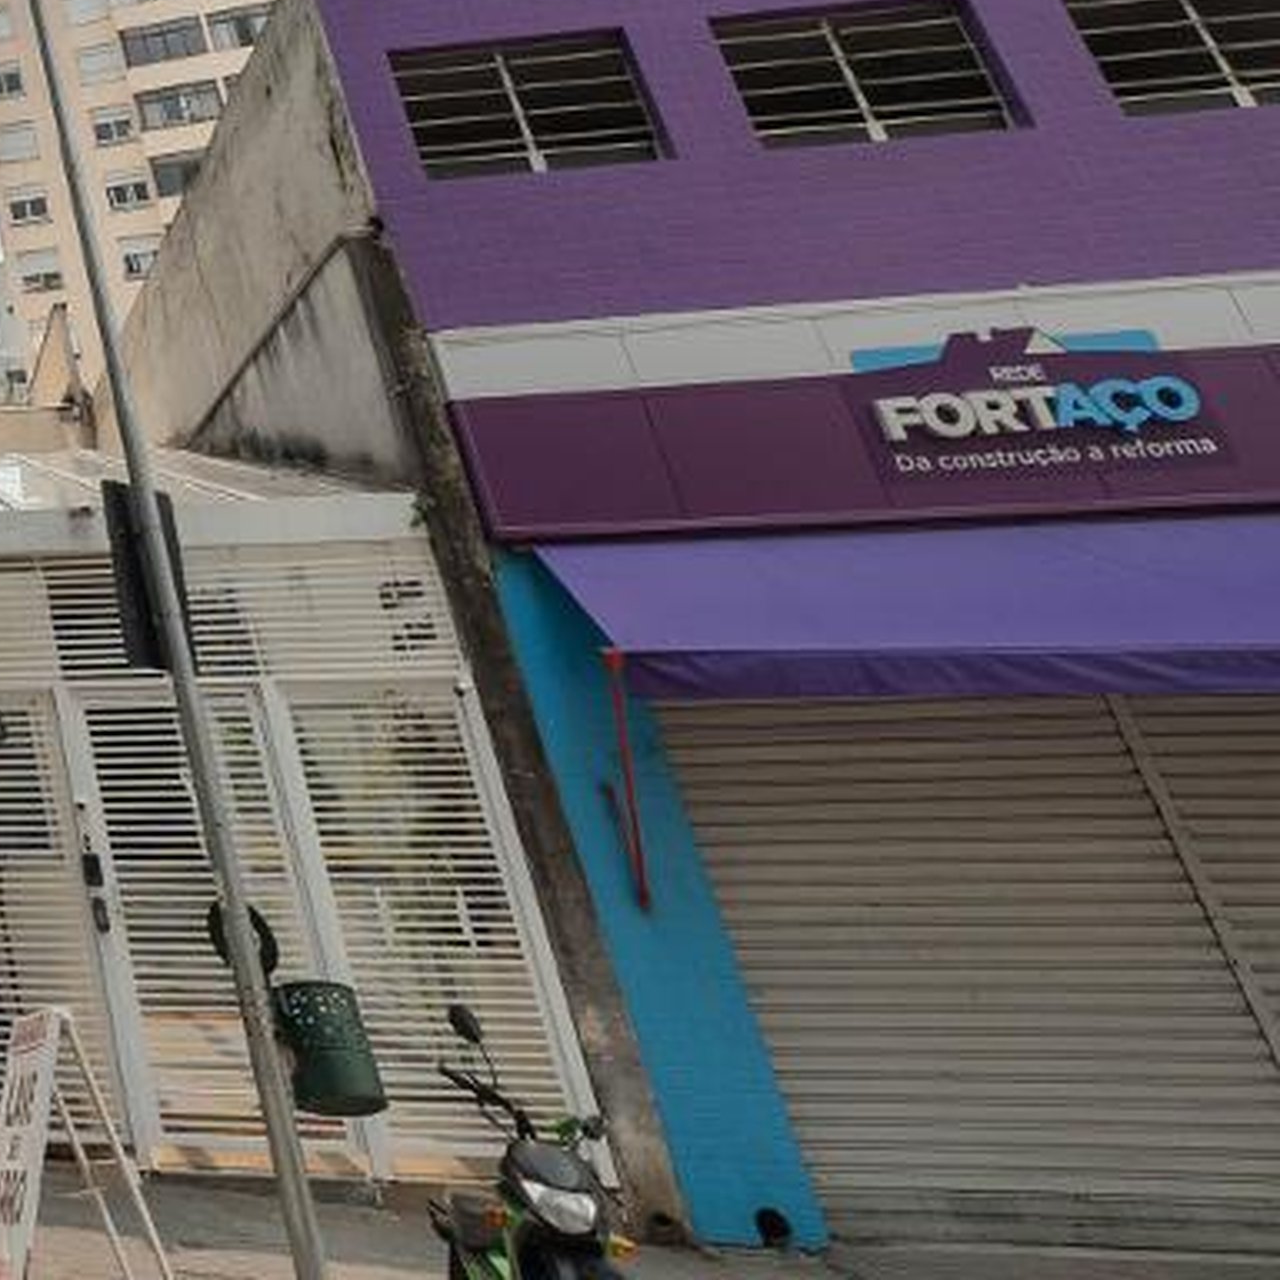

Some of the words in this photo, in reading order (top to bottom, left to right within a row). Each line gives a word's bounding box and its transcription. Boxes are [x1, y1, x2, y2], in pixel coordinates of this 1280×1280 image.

[990, 365, 1045, 382] REDE
[876, 376, 1200, 441] FORTAÇO
[895, 453, 931, 473] Da
[939, 443, 1081, 469] construção
[1112, 435, 1217, 459] reforma
